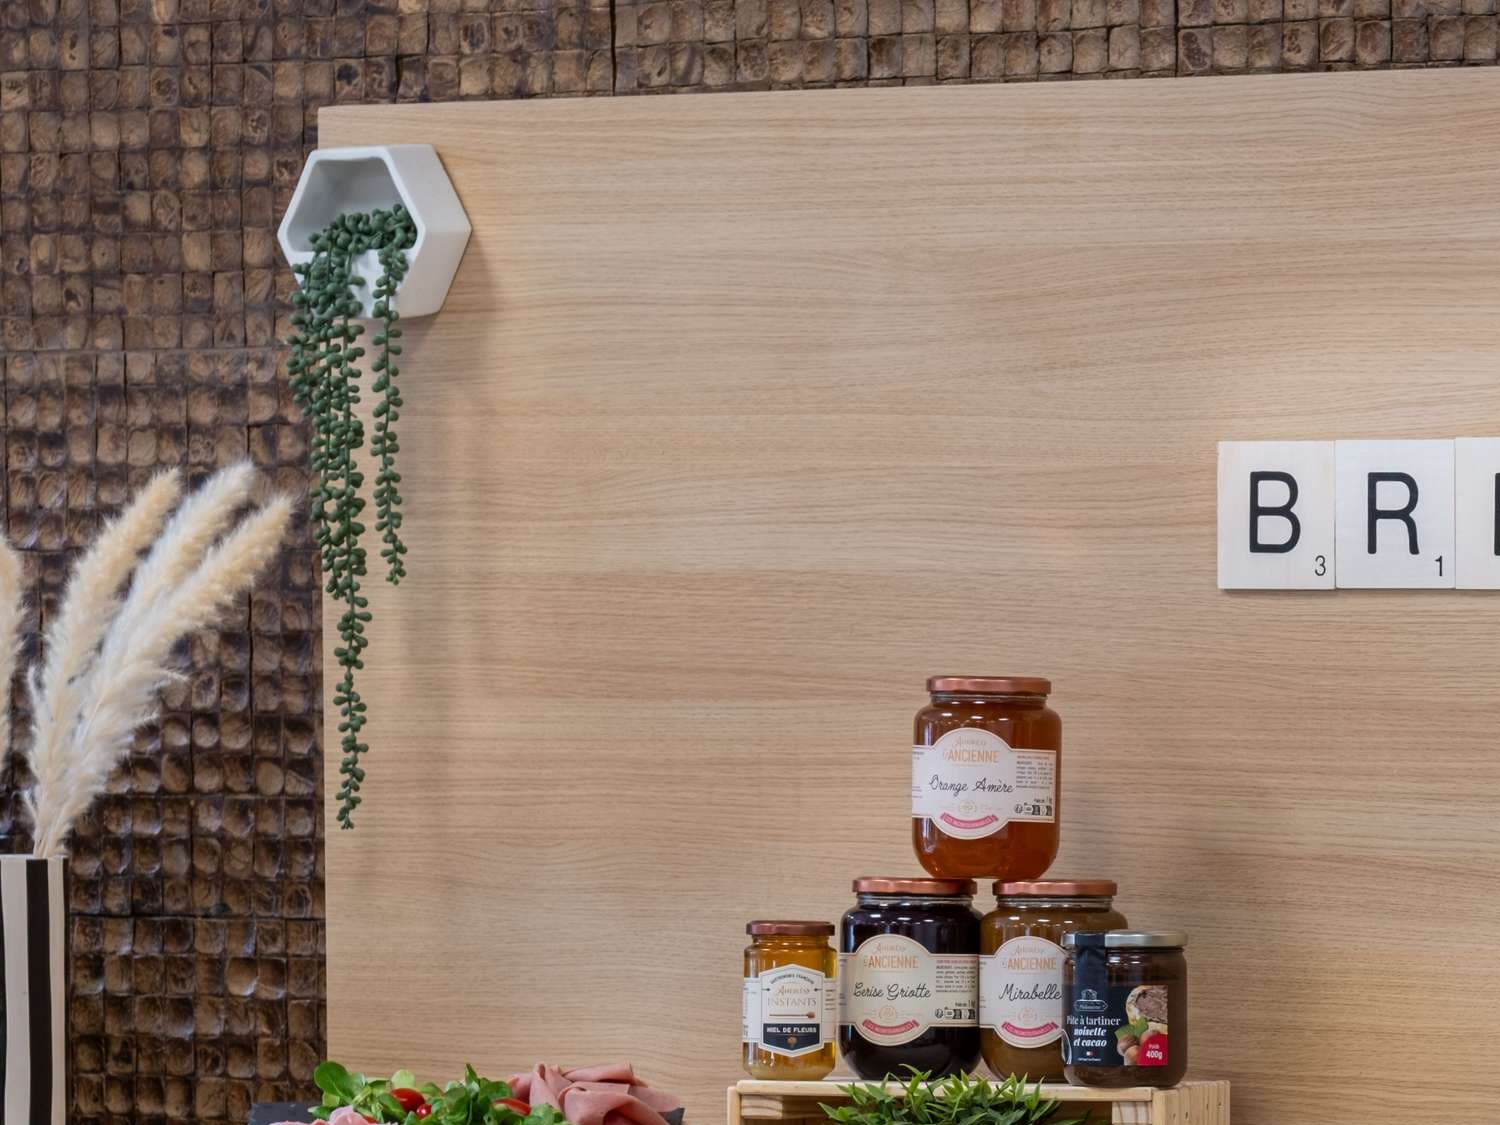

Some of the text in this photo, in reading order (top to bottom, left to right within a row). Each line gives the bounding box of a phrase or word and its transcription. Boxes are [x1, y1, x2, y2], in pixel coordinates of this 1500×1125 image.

[1314, 555, 1327, 577] 3
[1435, 555, 1444, 577] 1
[929, 774, 968, 797] Orange
[972, 777, 1014, 793] Amère
[853, 982, 931, 1000] Cerise Griotte
[999, 983, 1063, 1001] Mirabelle
[1086, 1016, 1121, 1026] tartiner
[1073, 1026, 1107, 1036] noisette
[1081, 1039, 1107, 1047] cacao
[1146, 1050, 1163, 1060] 400g
